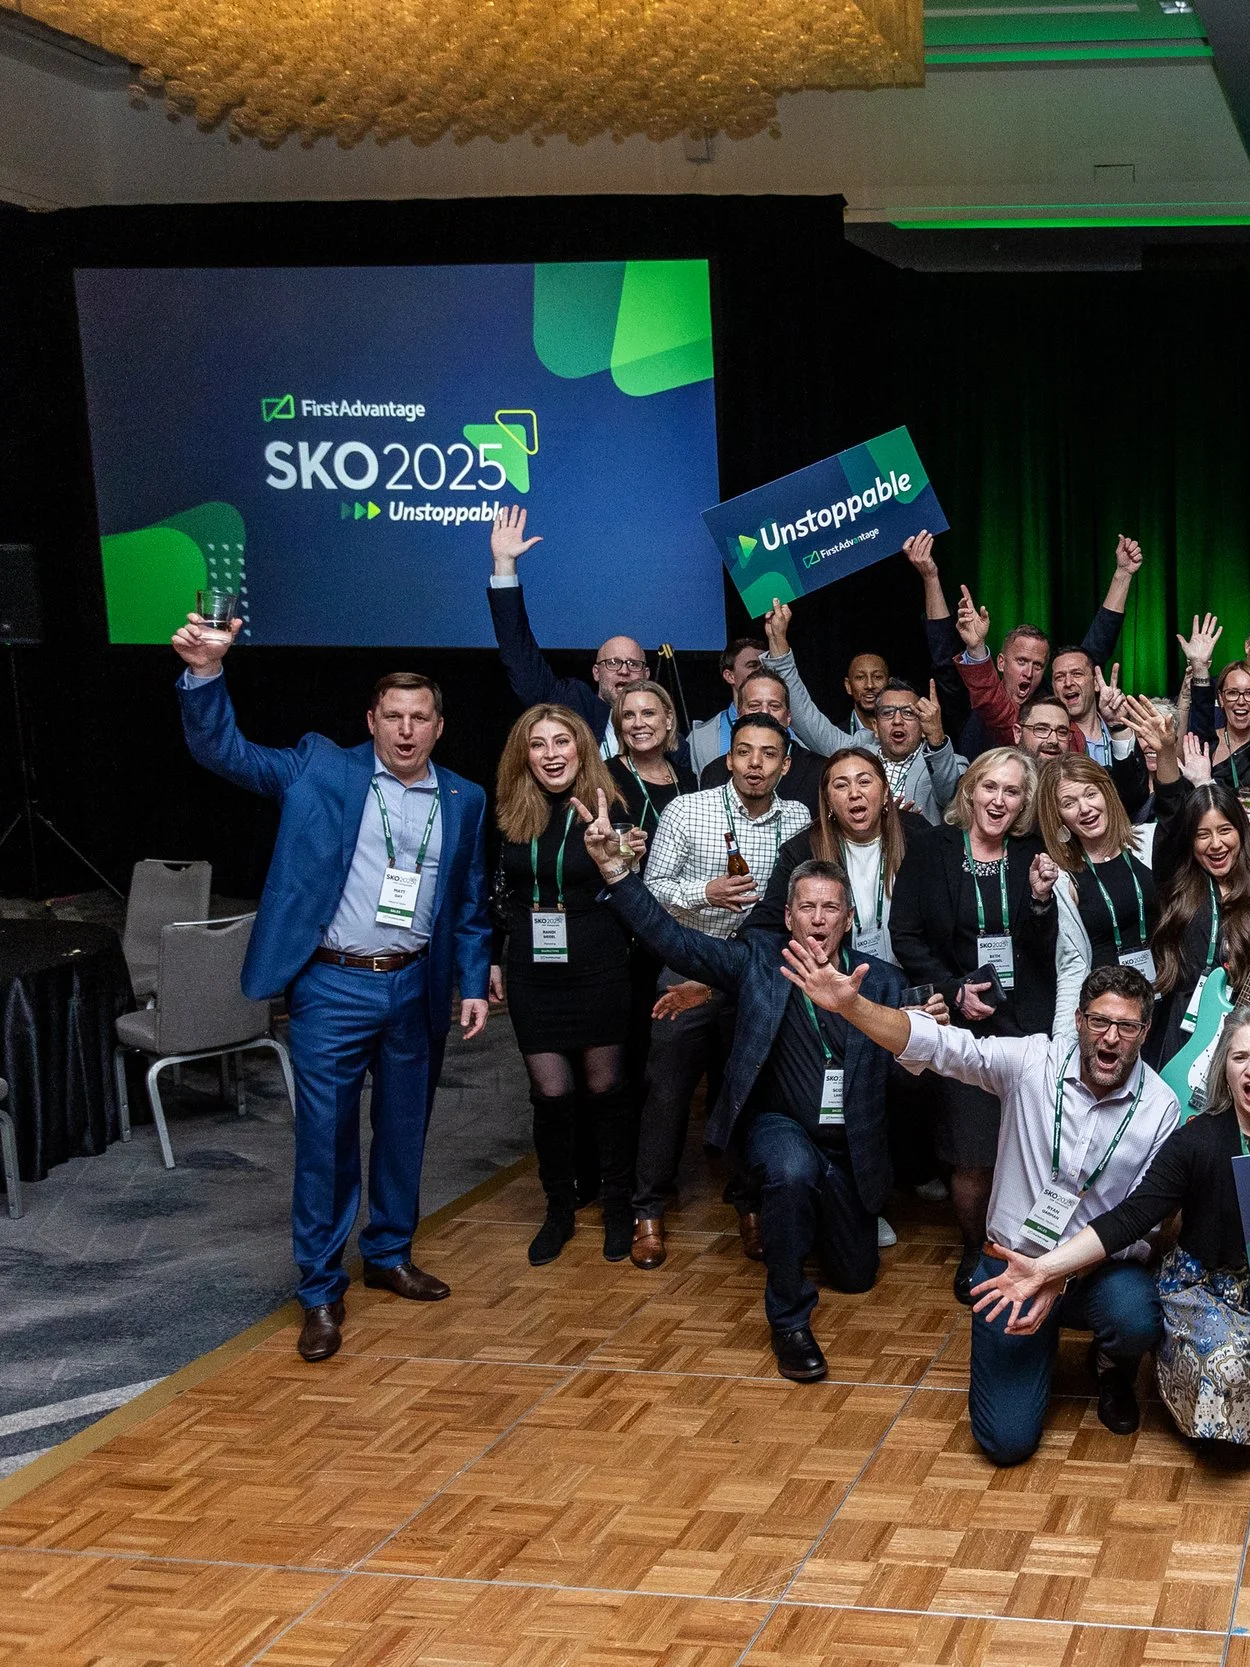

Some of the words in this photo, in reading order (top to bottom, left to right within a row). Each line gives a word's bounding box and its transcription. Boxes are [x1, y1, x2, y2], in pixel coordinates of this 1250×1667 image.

[301, 399, 426, 422] FirstAdvantage
[388, 501, 504, 526] Unstoppabl
[760, 470, 912, 551] Unstoppable
[820, 527, 880, 560] FirstAdvantage
